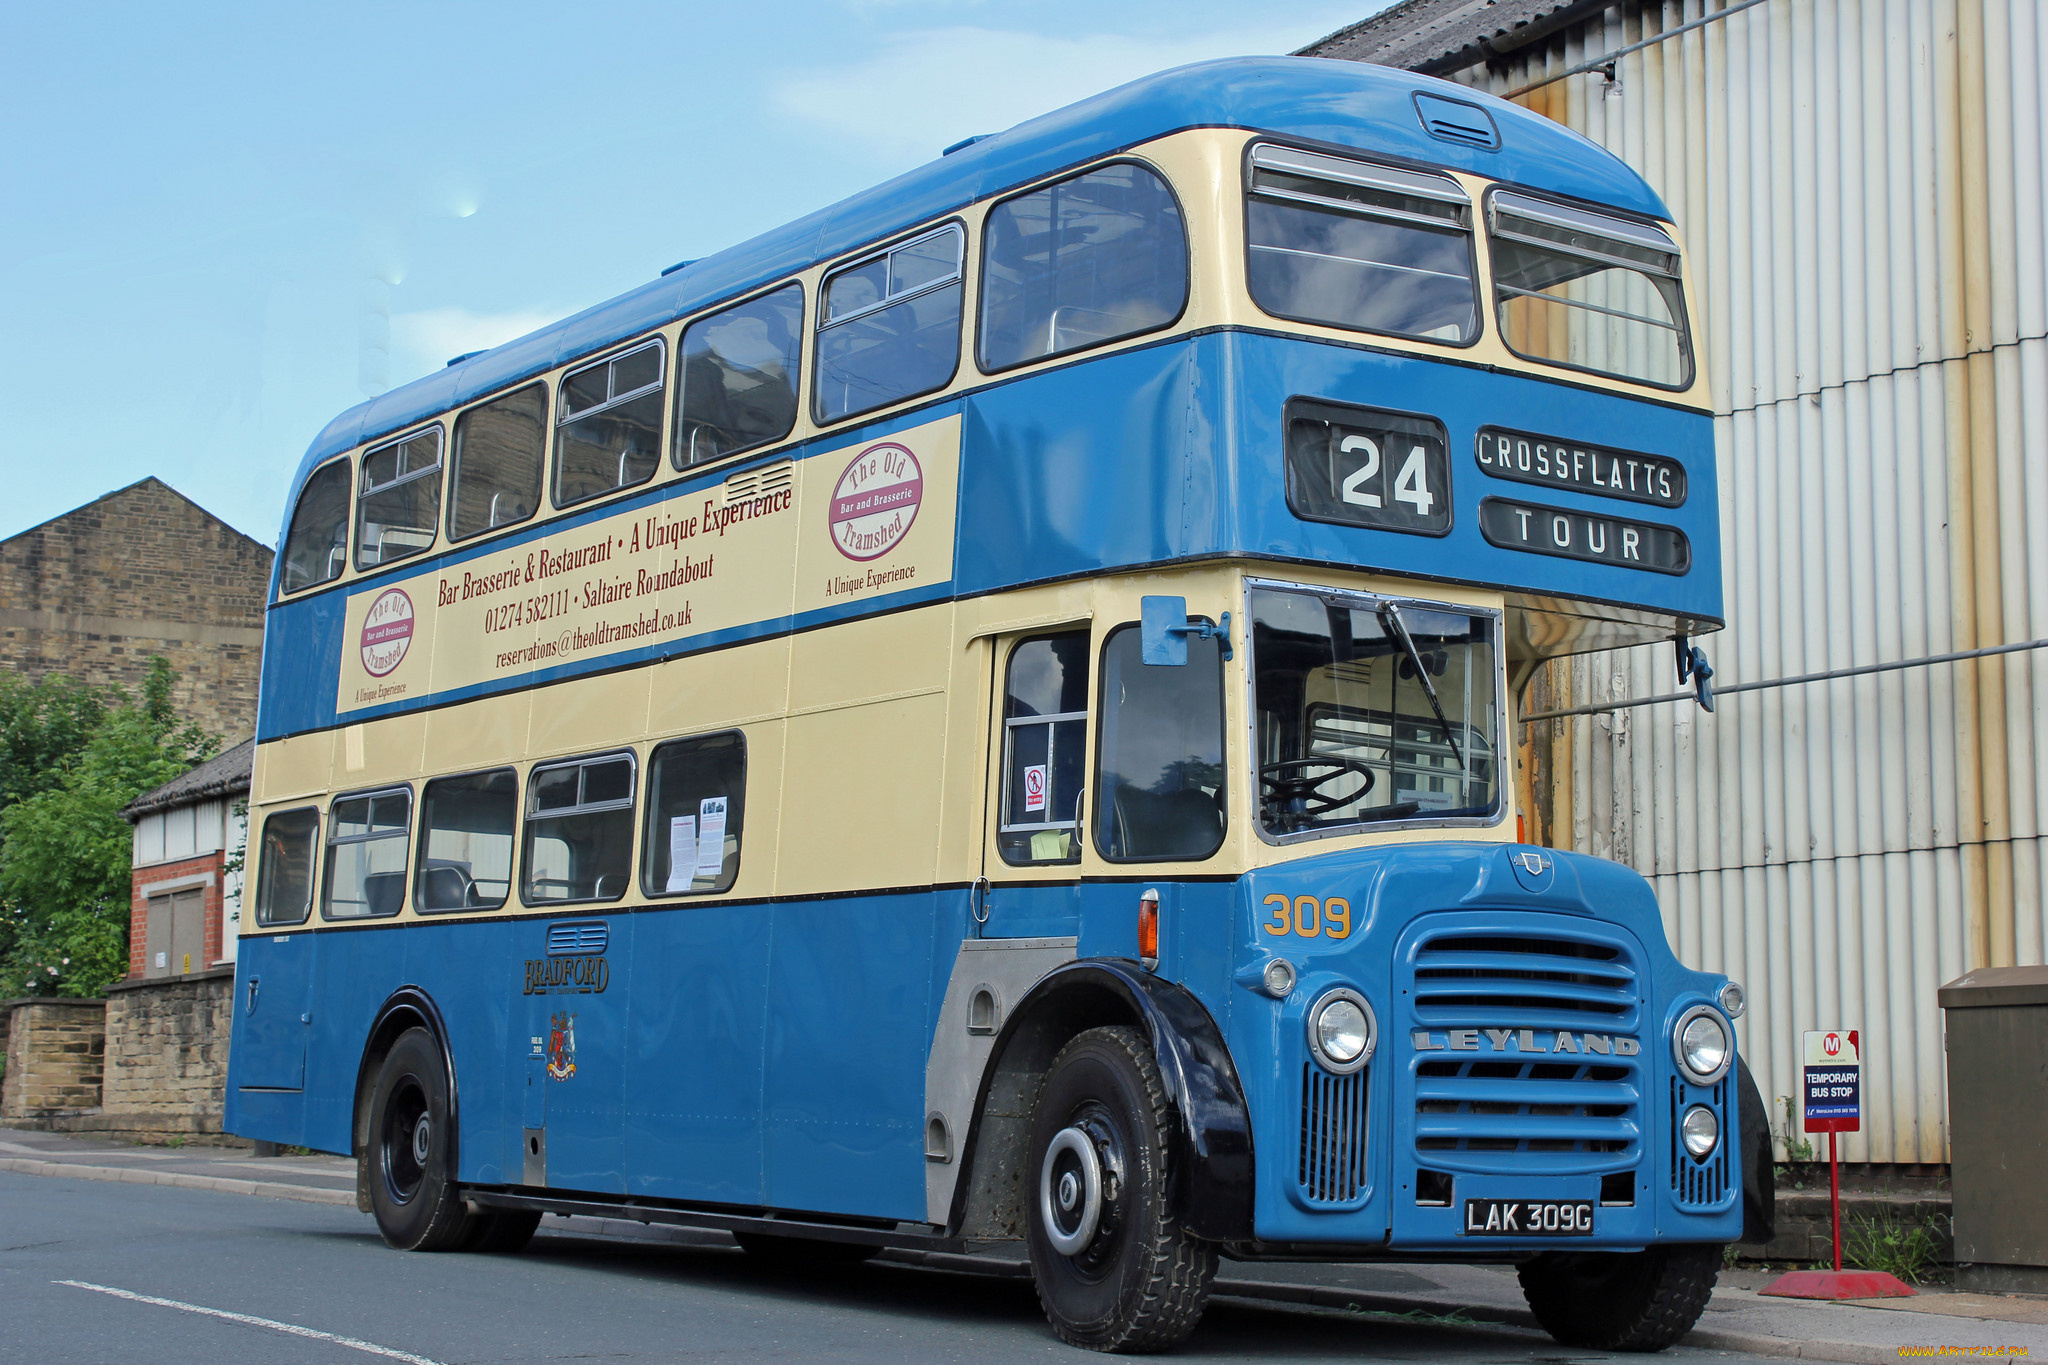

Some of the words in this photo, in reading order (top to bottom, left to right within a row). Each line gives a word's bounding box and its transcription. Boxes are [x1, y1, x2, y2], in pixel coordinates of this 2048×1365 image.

[849, 459, 876, 490] The
[884, 452, 906, 479] Old
[1340, 434, 1434, 515] 24
[1478, 432, 1672, 499] CROSSFLATTS
[840, 503, 854, 514] Bar
[856, 497, 871, 510] and
[874, 488, 913, 506] Brasserie
[438, 579, 459, 607] Bar
[462, 560, 520, 600] Brasserie
[524, 553, 535, 583] &
[538, 535, 612, 579] Restaurant
[629, 522, 640, 554] A
[646, 514, 697, 550] Unique
[702, 488, 792, 536] Experience
[843, 512, 902, 550] Tramshed
[1515, 509, 1640, 561] TOUR
[485, 601, 522, 634] 01274
[525, 588, 569, 625] 582111
[582, 576, 632, 609] Saltaire
[636, 553, 714, 596] Roundabout
[826, 579, 832, 597] A
[834, 575, 864, 595] Unique
[866, 564, 915, 590] Experience
[373, 601, 388, 623] The
[392, 596, 405, 617] Old
[367, 632, 375, 641] Bar
[376, 629, 384, 639] and
[385, 623, 408, 637] Brasserie
[496, 600, 692, 668] reservations@theoldtramshed.co.uk
[367, 642, 401, 669] Tramshed
[360, 687, 377, 703] Unique
[378, 682, 407, 700] Experience
[1263, 893, 1352, 939] 309
[523, 957, 609, 995] BRADFORD
[1413, 1029, 1640, 1057] LEYLAND
[1825, 1037, 1839, 1052] M
[1806, 1073, 1857, 1084] TEMPORARY
[1811, 1087, 1829, 1098] BUS
[1831, 1087, 1853, 1097] STOP
[1468, 1203, 1519, 1231] LAK
[1526, 1203, 1591, 1231] 309G
